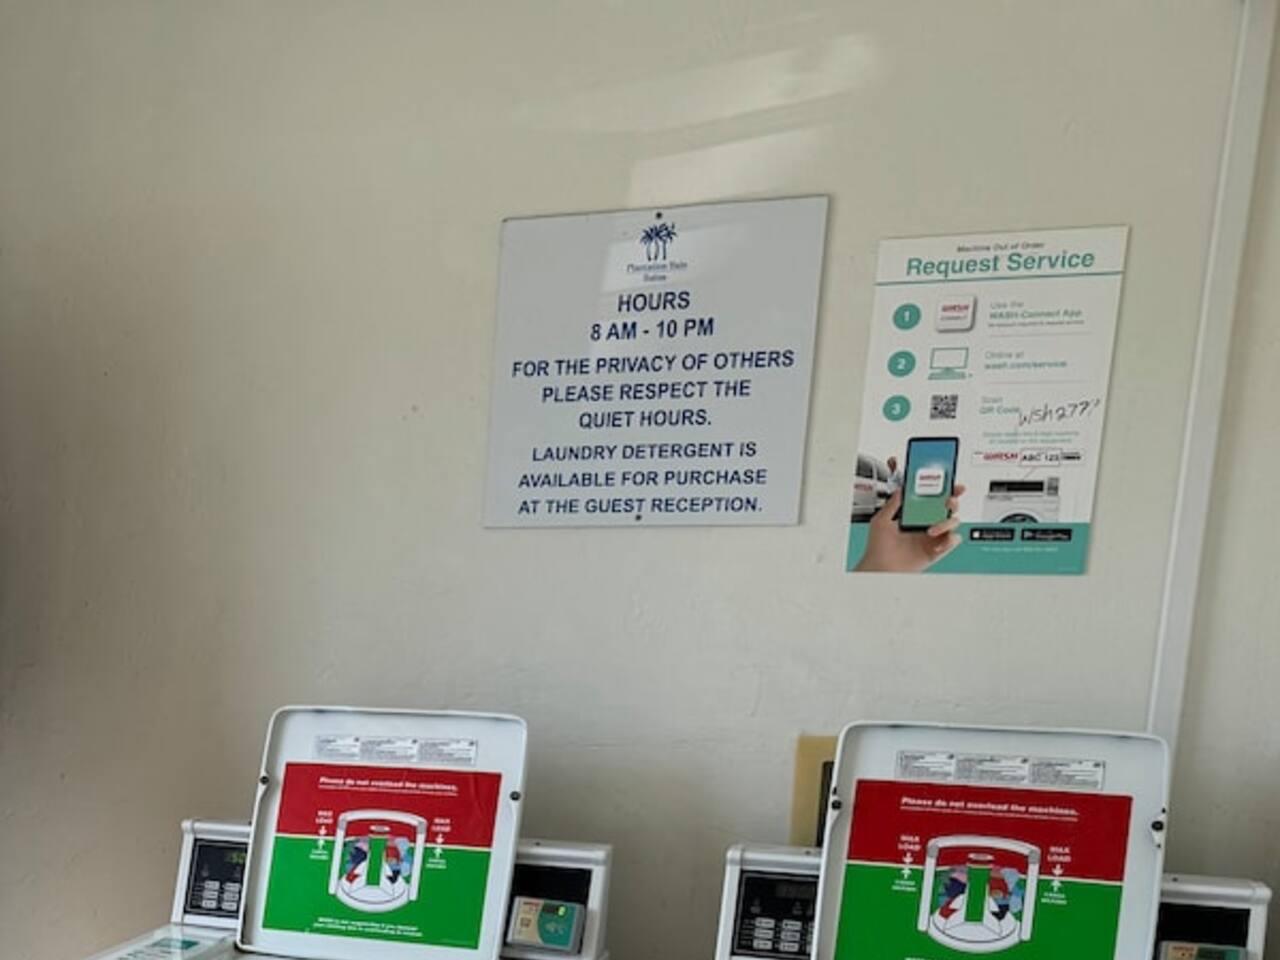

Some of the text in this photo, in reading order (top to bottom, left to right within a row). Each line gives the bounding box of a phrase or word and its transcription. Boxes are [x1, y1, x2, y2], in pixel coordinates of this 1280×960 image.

[906, 250, 1095, 278] Request Service
[617, 291, 691, 313] HOURS
[904, 310, 911, 322] 1
[590, 322, 601, 341] 8
[606, 321, 638, 341] AM
[656, 319, 678, 339] 10
[684, 317, 715, 338] PM
[512, 349, 794, 378] FOR THE PRIVACY OF OTHERS
[897, 357, 906, 370] 2
[542, 379, 752, 403] PLEASE RESPECT THE
[891, 402, 901, 414] 3
[579, 409, 712, 430] QUIET HOURS.
[532, 441, 757, 462] LAUNDRY DETERGENT IS
[518, 468, 768, 489] AVAILABLE FOR PURCHASE
[518, 496, 763, 515] AT THE GUEST RECEPTION.
